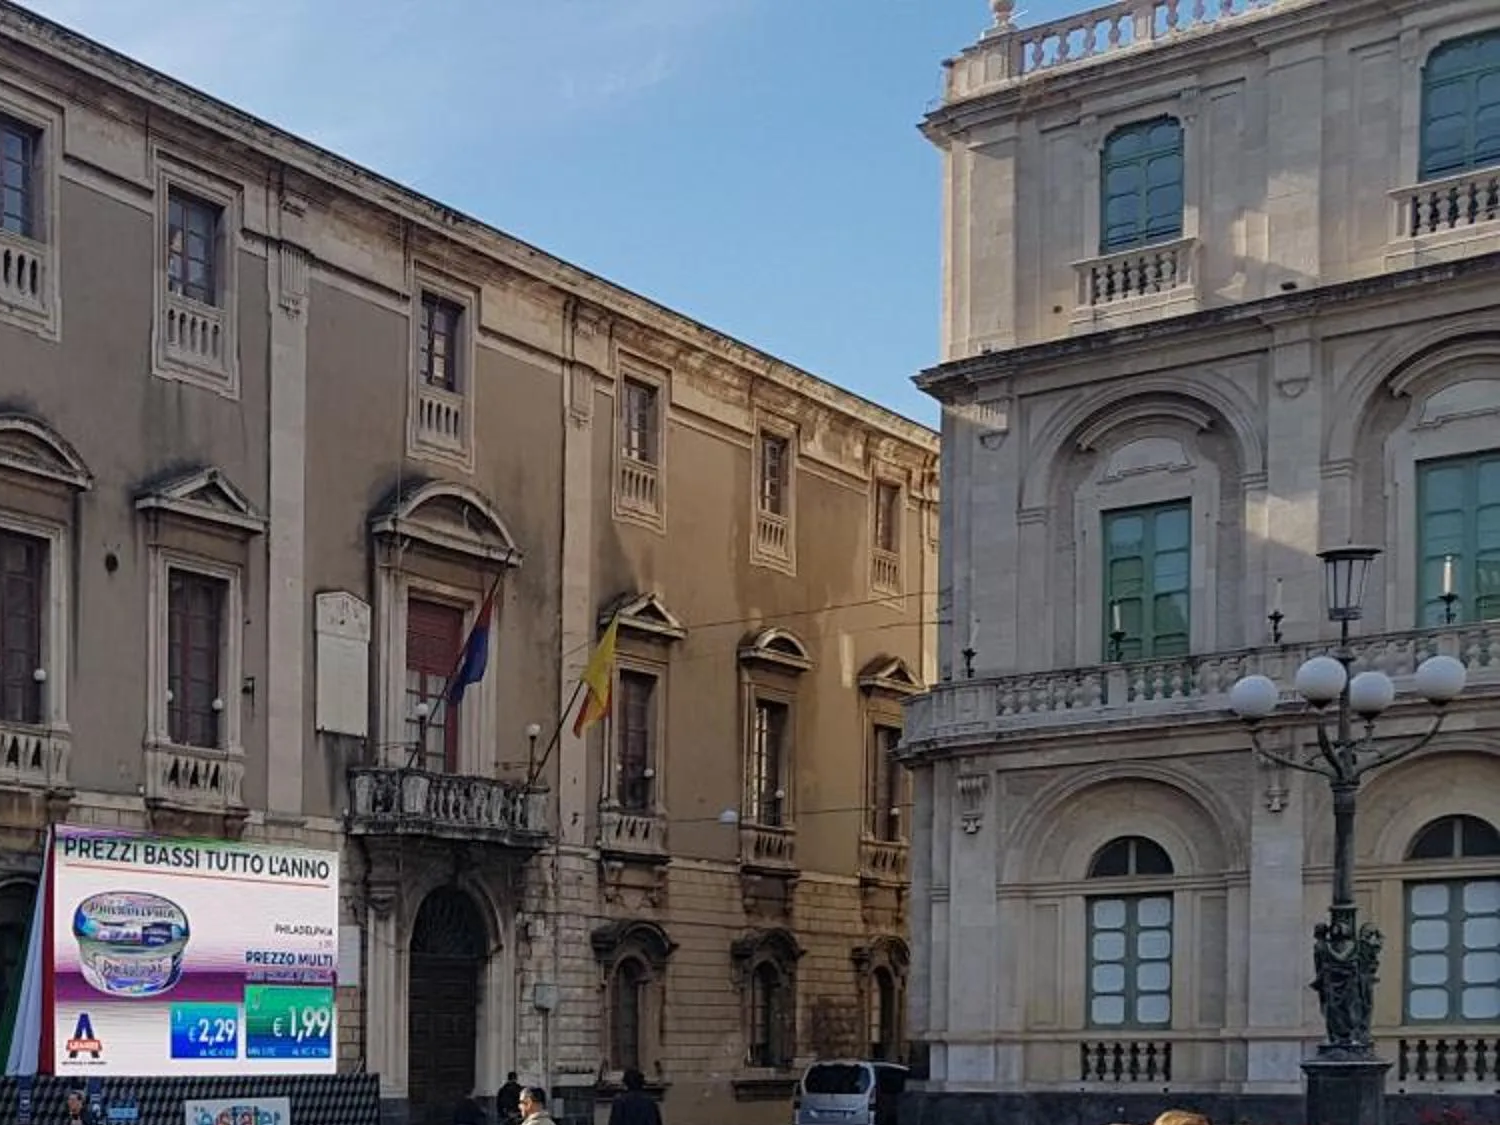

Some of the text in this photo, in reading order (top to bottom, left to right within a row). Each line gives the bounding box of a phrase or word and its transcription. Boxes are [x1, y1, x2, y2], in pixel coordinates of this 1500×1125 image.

[64, 836, 329, 879] PREZZI BASSI TUTTO L'ANNO
[275, 923, 333, 936] PHILADELPHIA
[245, 951, 333, 967] PREZZO MULTI
[199, 1018, 236, 1046] 2,29
[288, 1006, 331, 1043] 1,99
